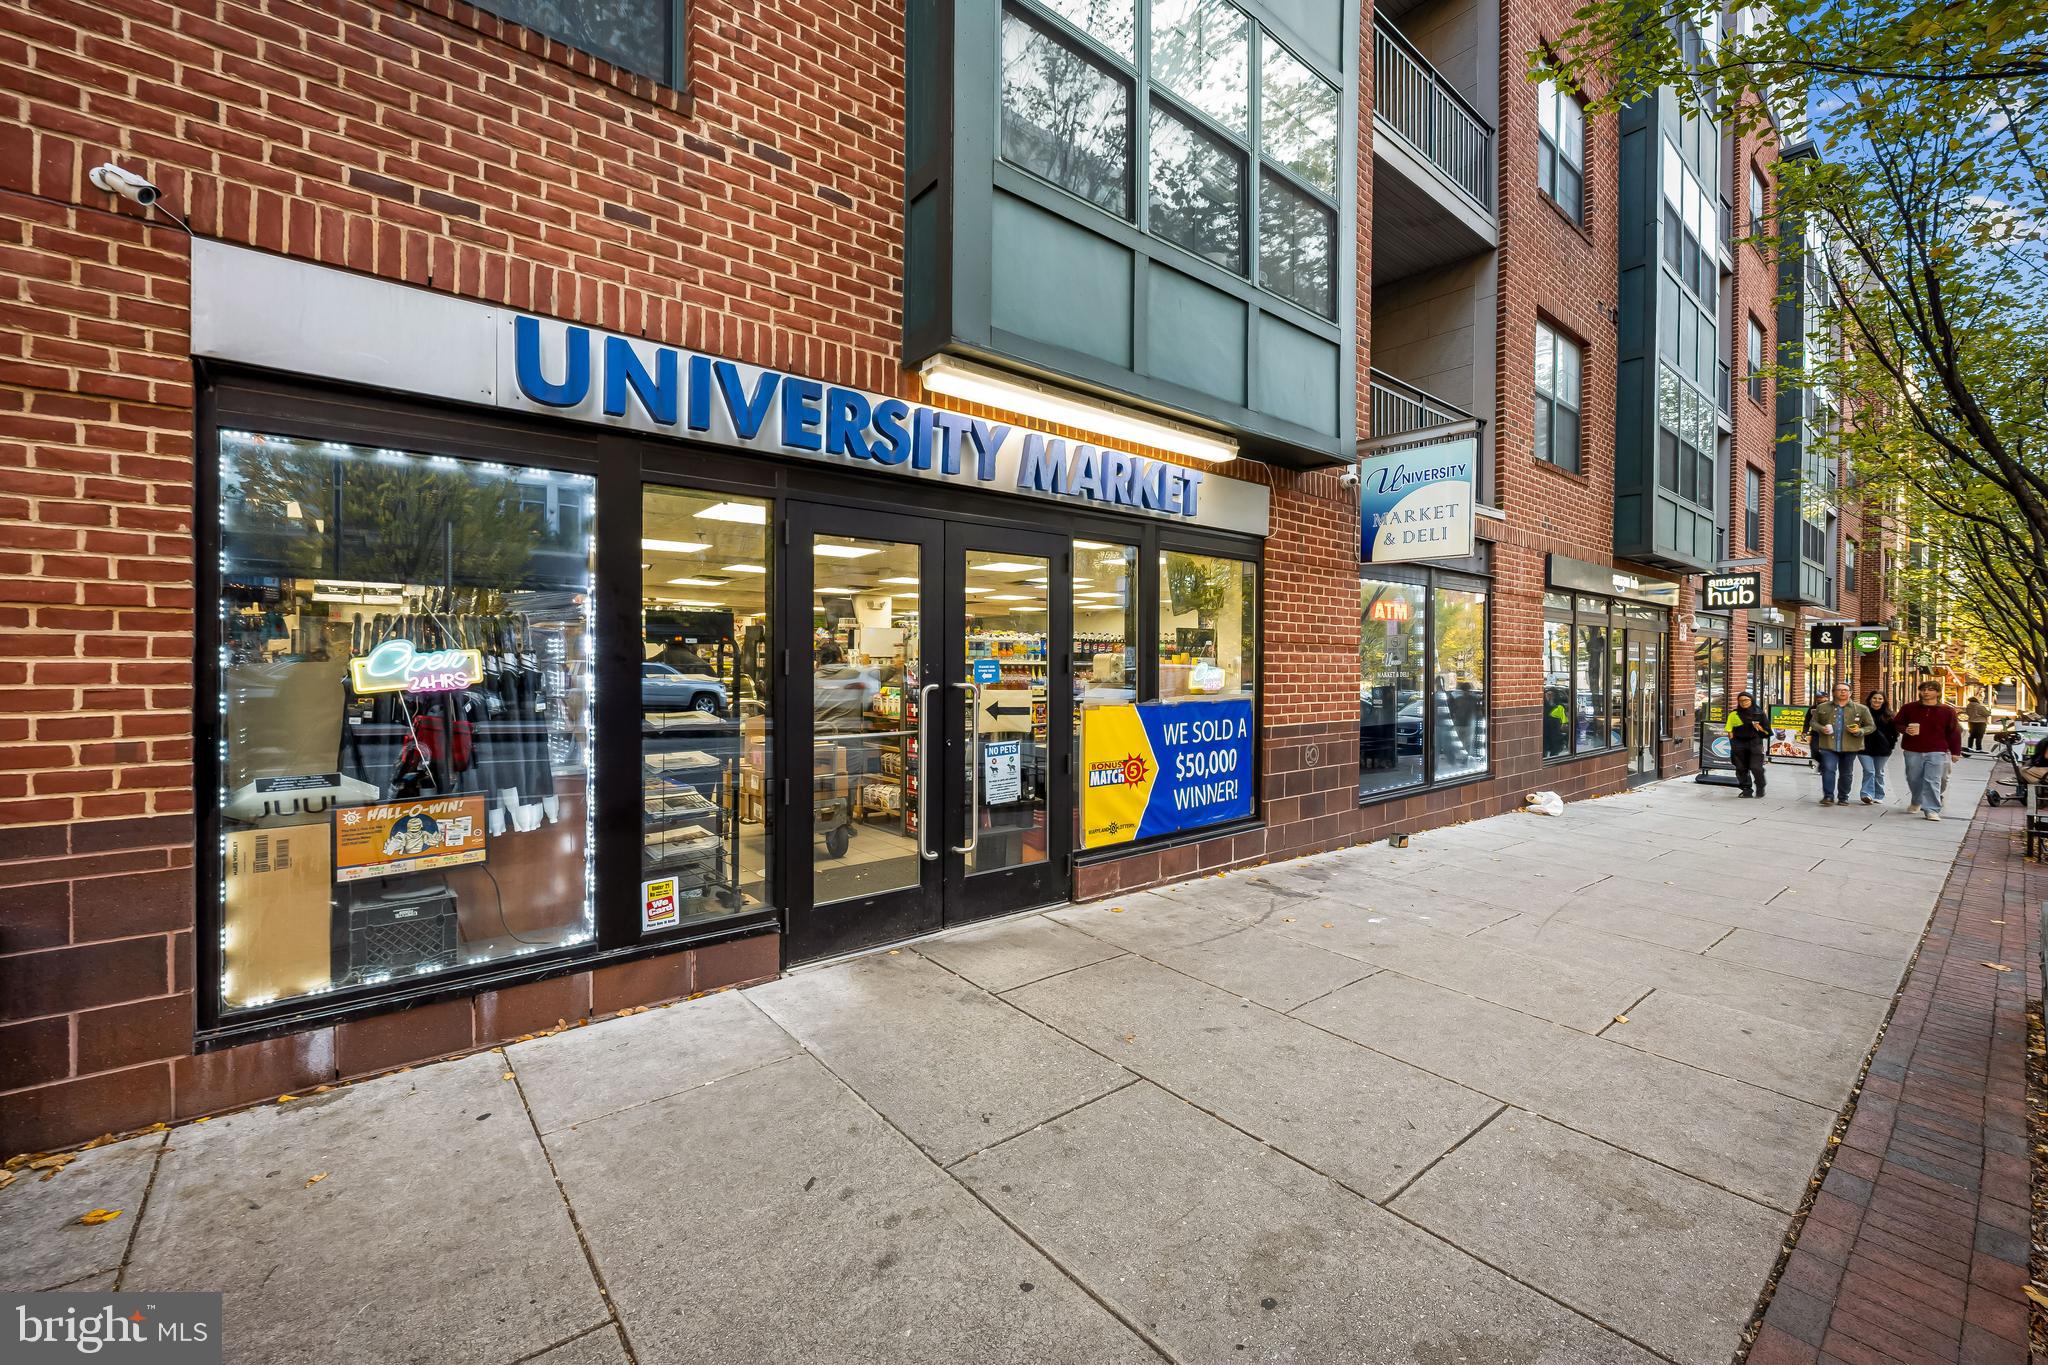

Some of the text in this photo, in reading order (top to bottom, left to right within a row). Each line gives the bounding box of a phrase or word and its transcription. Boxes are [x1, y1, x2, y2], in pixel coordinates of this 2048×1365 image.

[514, 315, 1203, 517] UNIVERSITY MARKET
[1366, 464, 1467, 494] UNIVERSITY
[1372, 503, 1459, 528] MARKET
[1383, 526, 1448, 546] & DELI
[1708, 577, 1754, 587] amazon
[1708, 586, 1754, 606] hub
[1374, 603, 1408, 620] ATM
[1820, 631, 1832, 644] &
[367, 639, 467, 681] Open
[410, 671, 469, 690] 24HRS
[1163, 717, 1247, 746] WE SOLD A
[988, 744, 1017, 756] NO PETS
[1091, 761, 1122, 771] BONUS
[1176, 748, 1237, 782] $50,000
[1090, 765, 1138, 787] MATCH 5
[1173, 779, 1238, 811] WINNER!
[366, 800, 465, 821] HALL-O-WIN!
